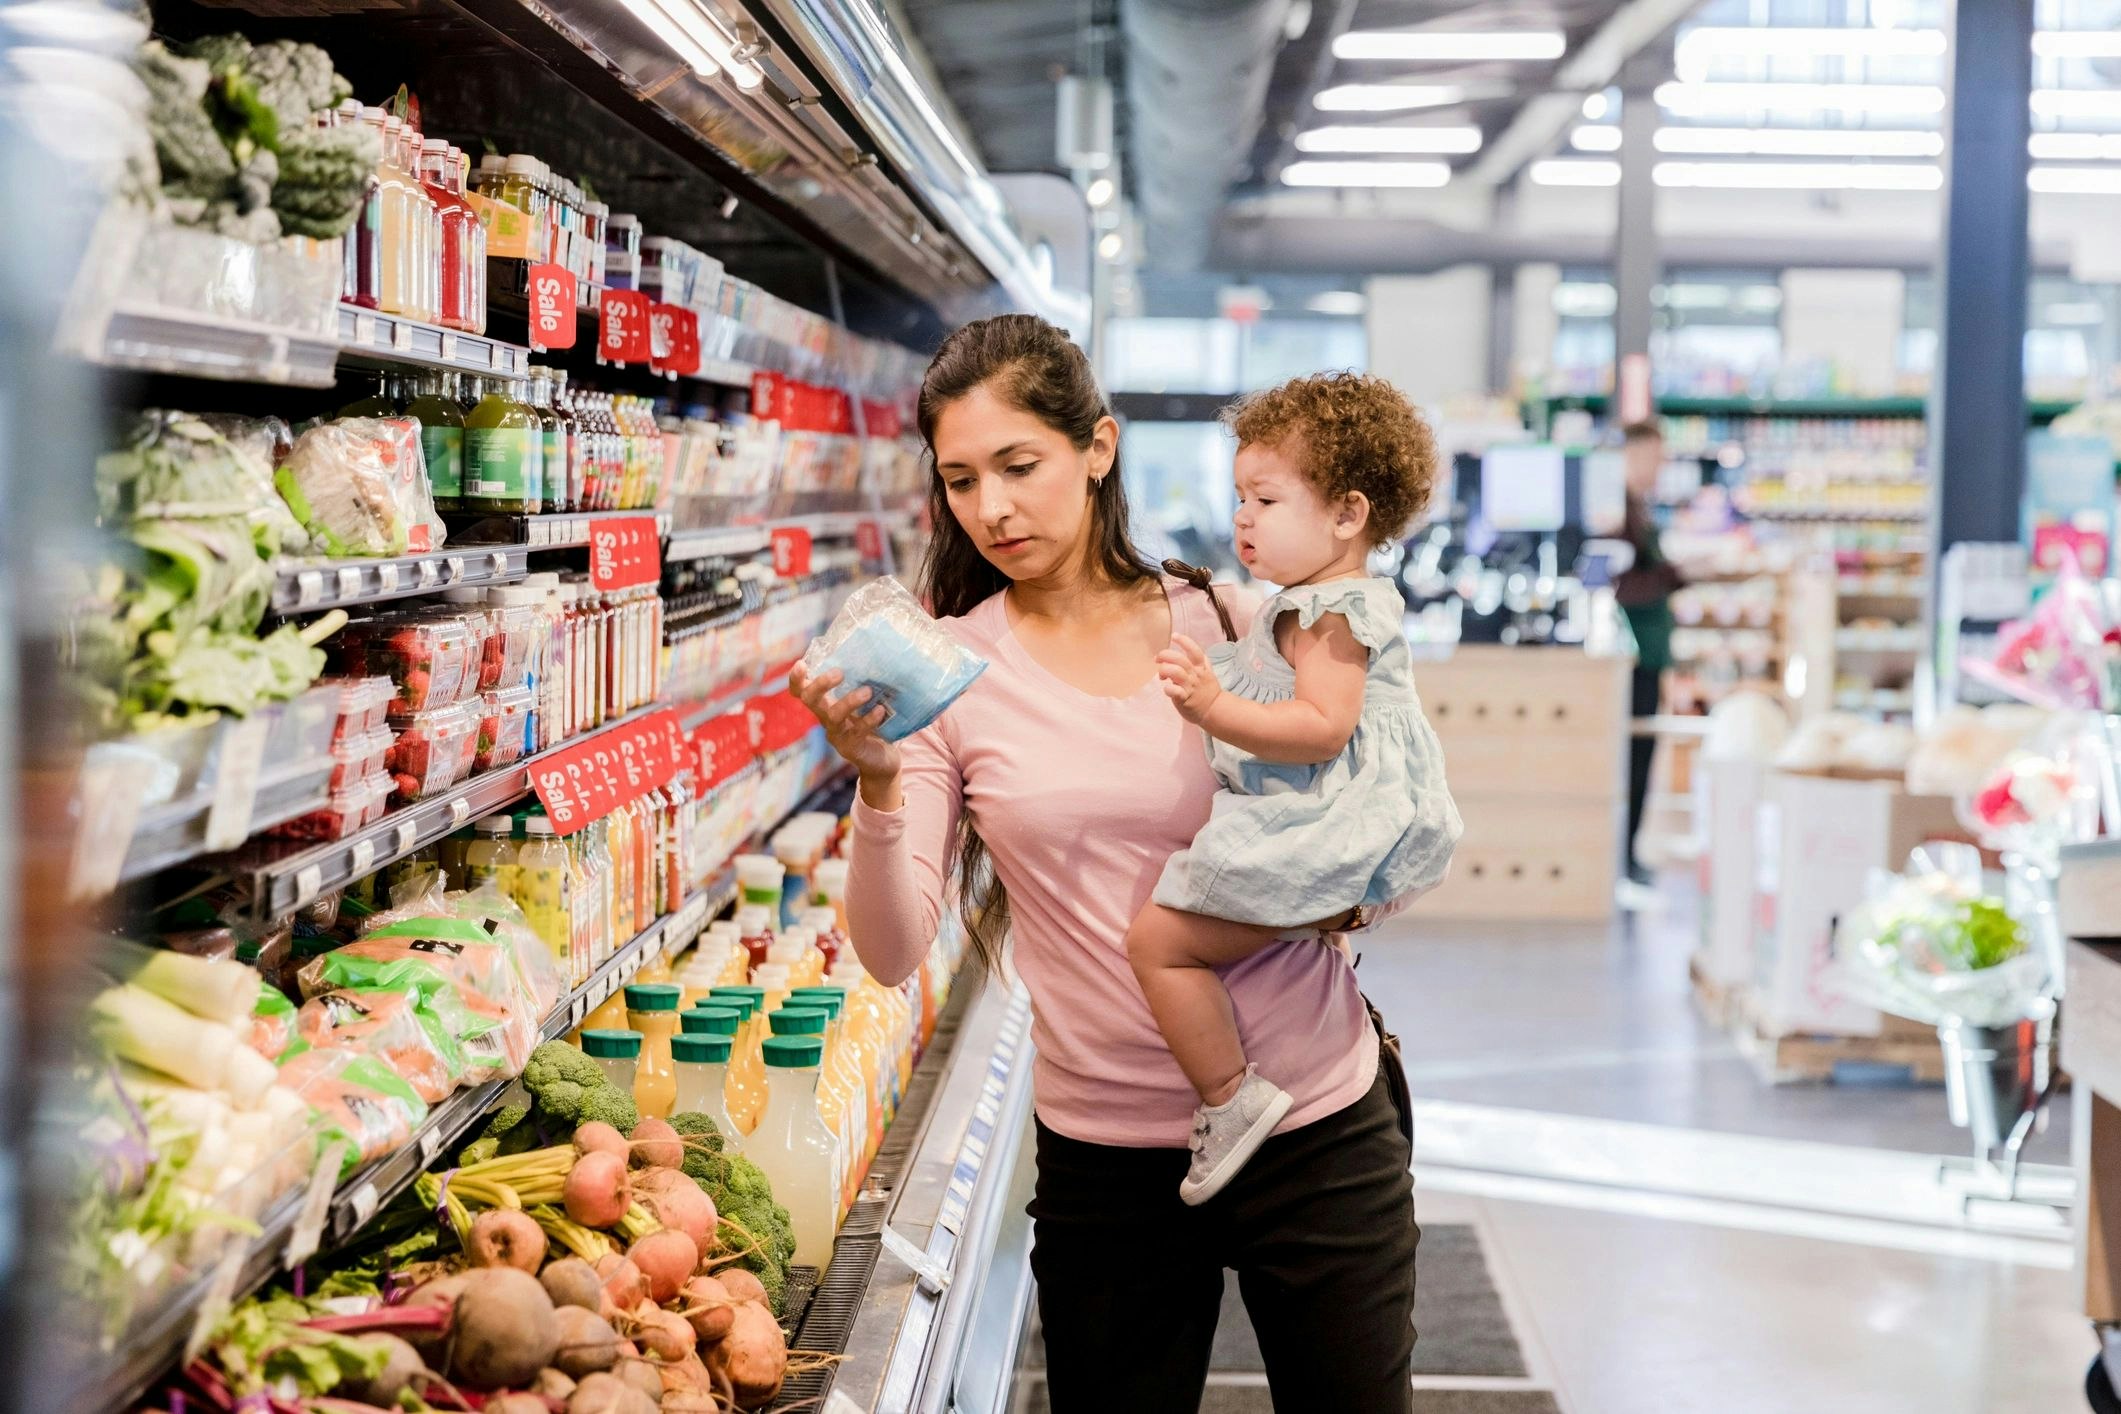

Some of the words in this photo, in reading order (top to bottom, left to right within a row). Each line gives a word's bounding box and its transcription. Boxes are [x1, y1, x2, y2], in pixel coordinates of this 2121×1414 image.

[536, 277, 563, 331] Sale
[605, 300, 628, 349] Sale
[595, 531, 618, 580] Sale
[540, 771, 575, 822] Sale
